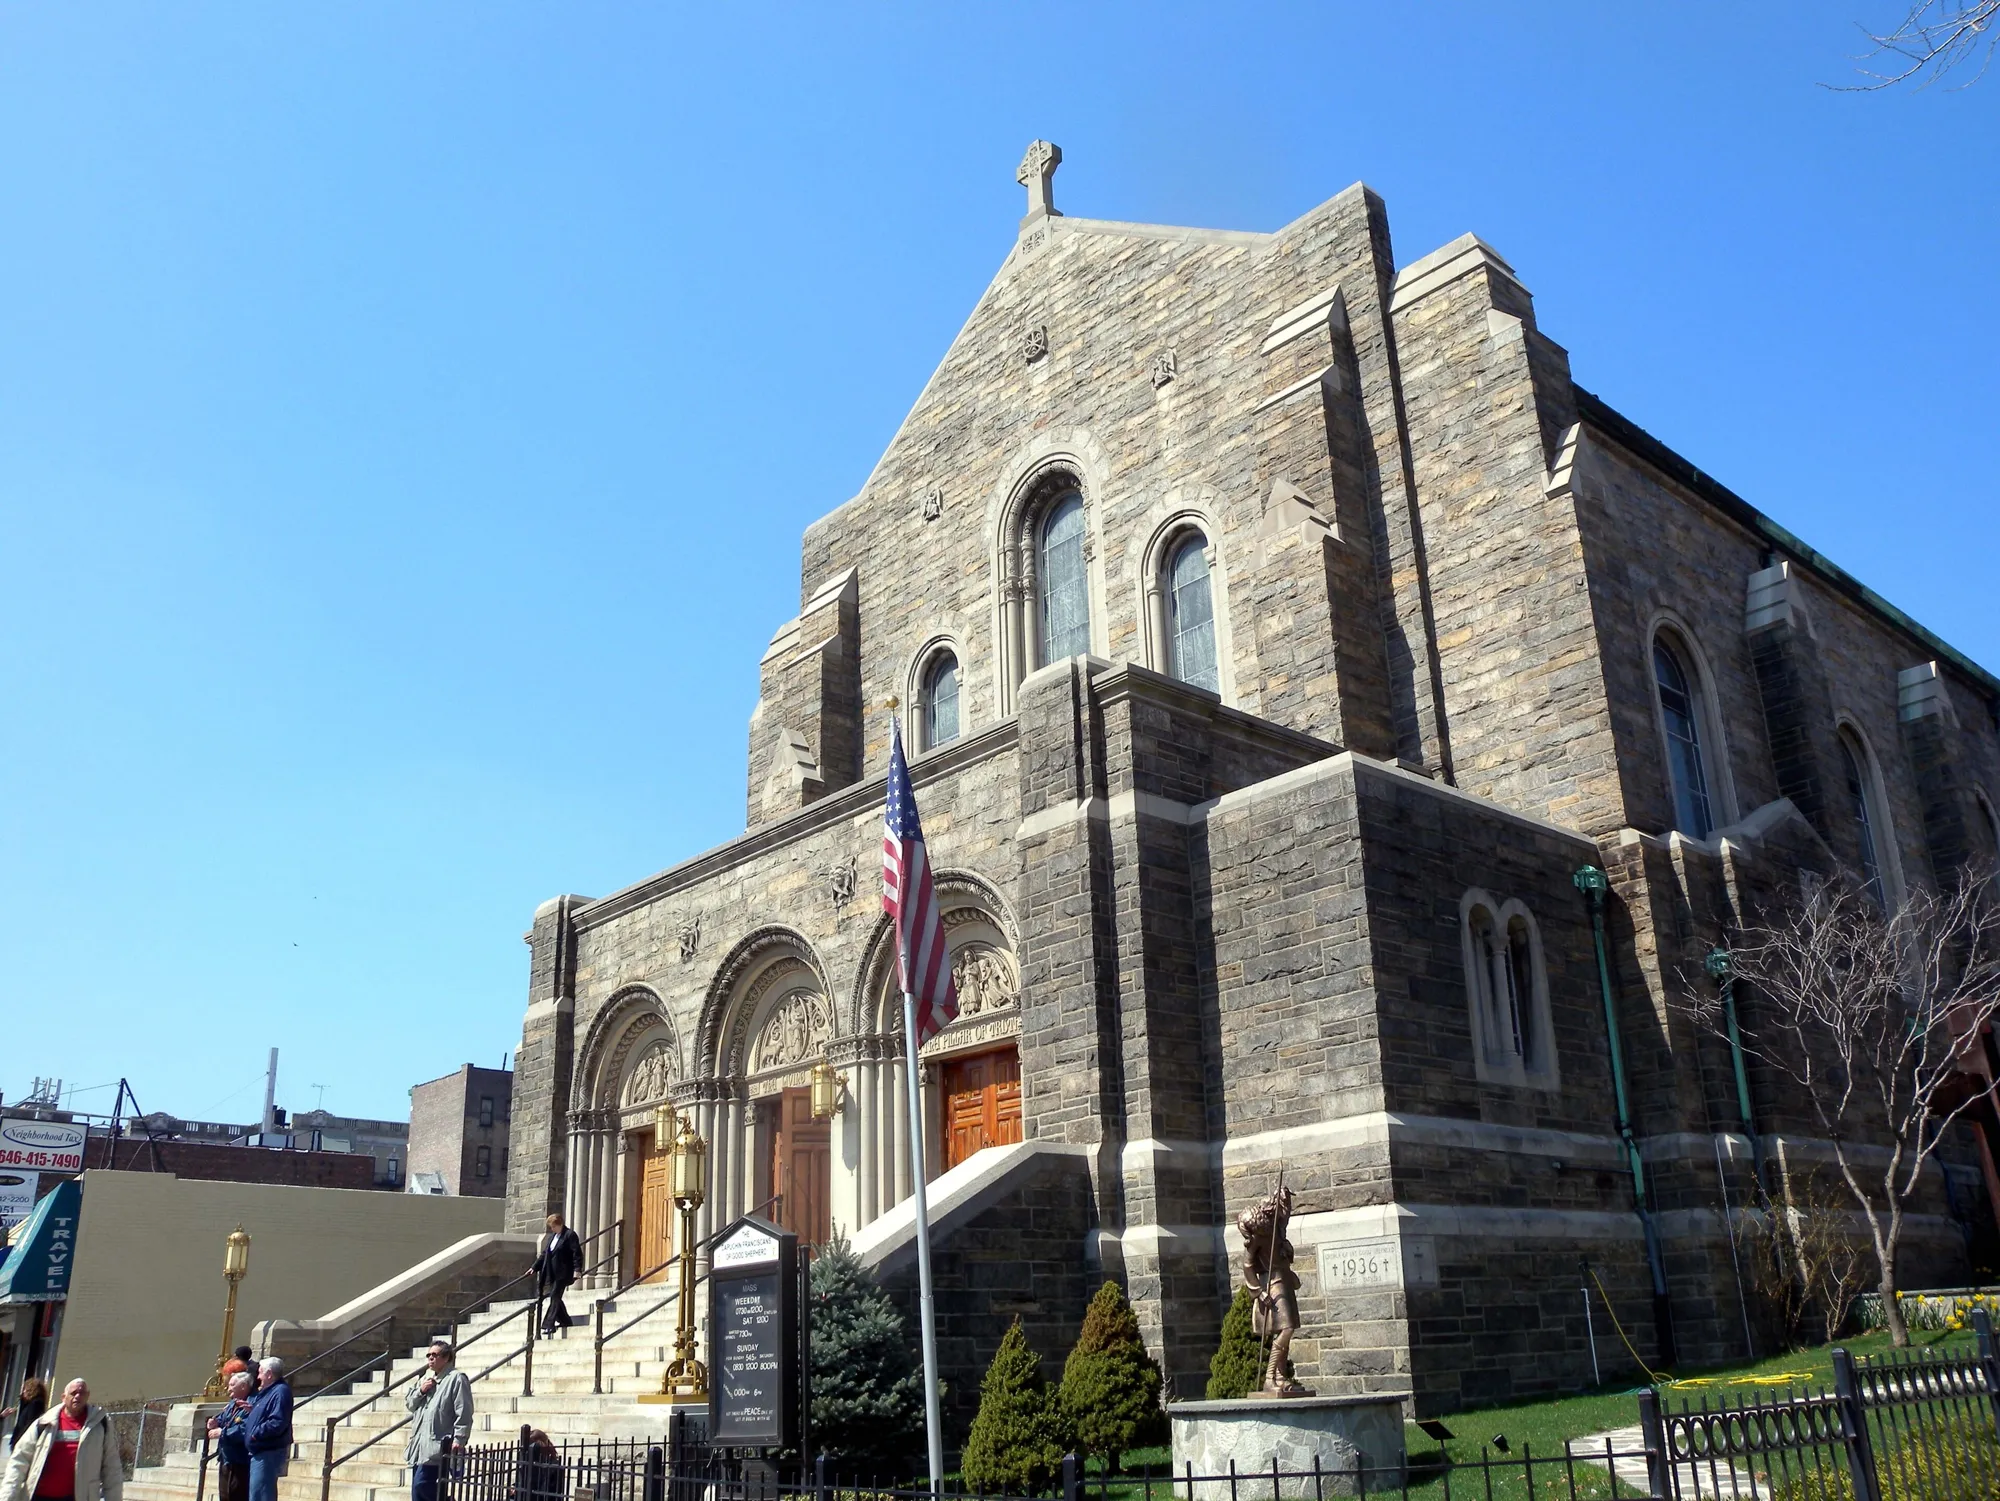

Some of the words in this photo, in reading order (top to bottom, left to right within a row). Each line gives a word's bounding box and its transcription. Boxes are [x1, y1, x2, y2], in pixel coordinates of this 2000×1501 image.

[943, 1028, 973, 1049] PILLAR
[975, 1023, 987, 1040] OF
[10, 1128, 64, 1141] Neighborhood
[65, 1132, 80, 1142] Tax
[0, 1149, 81, 1169] 646-415-7490
[742, 1236, 772, 1248] FRANCISCANS
[47, 1217, 72, 1289] TRAVEL
[1342, 1255, 1378, 1278] 1936
[742, 1283, 758, 1292] MASS
[742, 1317, 754, 1325] SAT
[756, 1315, 769, 1324] 1200
[736, 1343, 759, 1352] SUNDAY
[745, 1362, 758, 1370] 1200
[744, 1407, 761, 1416] PEACE
